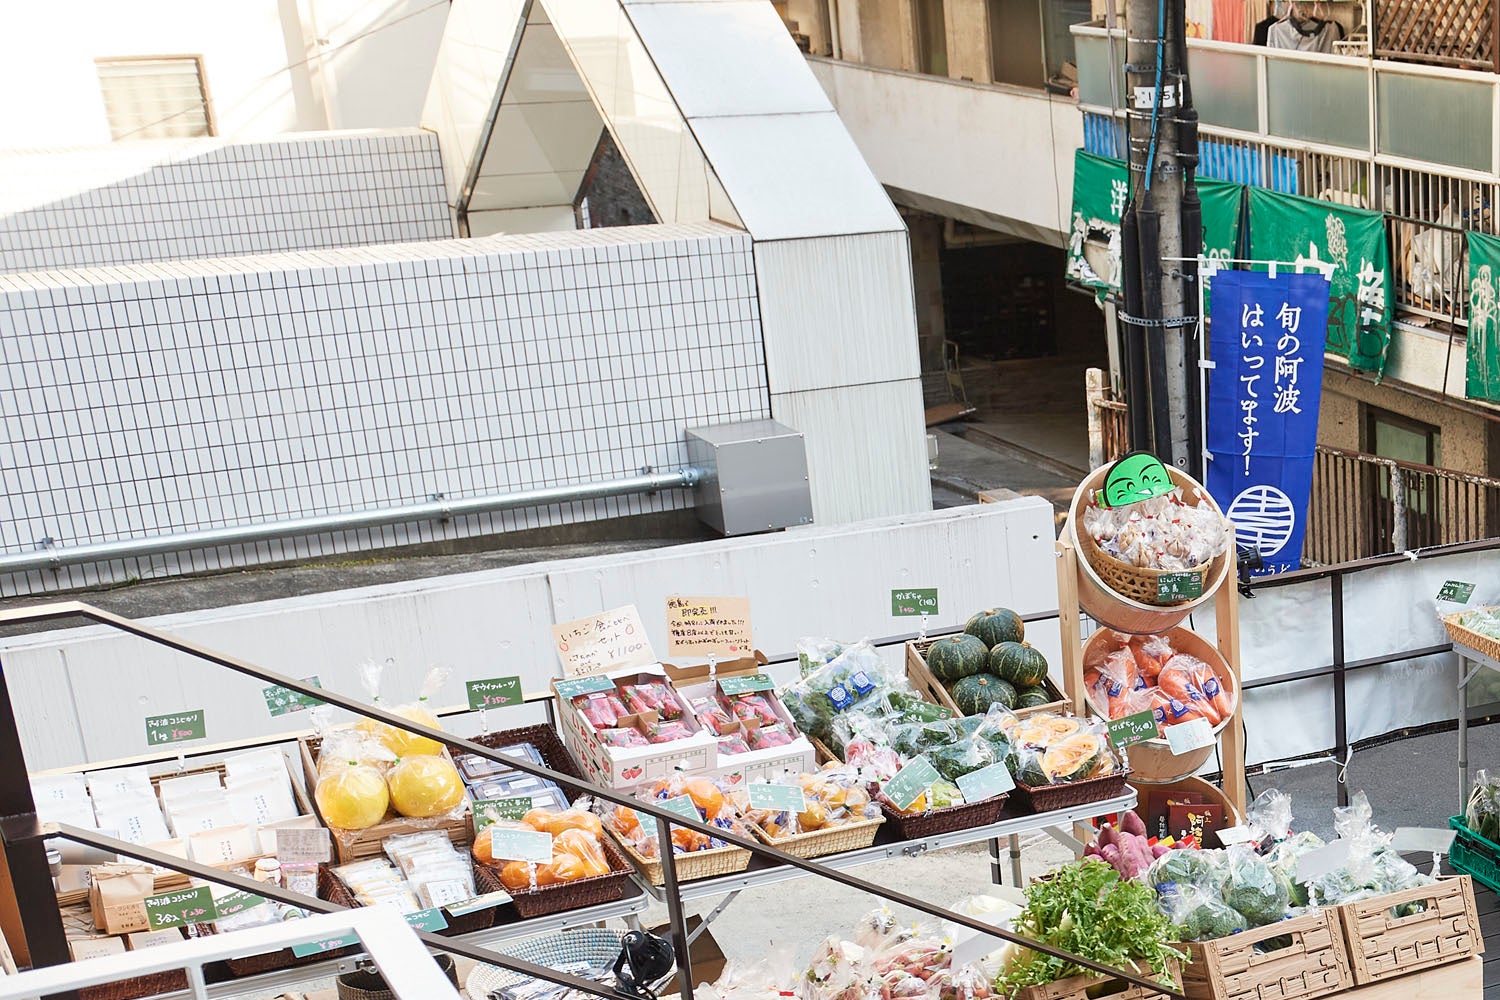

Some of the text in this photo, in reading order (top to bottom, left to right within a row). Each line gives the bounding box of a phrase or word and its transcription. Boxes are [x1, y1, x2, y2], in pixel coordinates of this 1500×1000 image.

[1273, 302, 1304, 414] 旬の阿波
[571, 714, 597, 757] いちご
